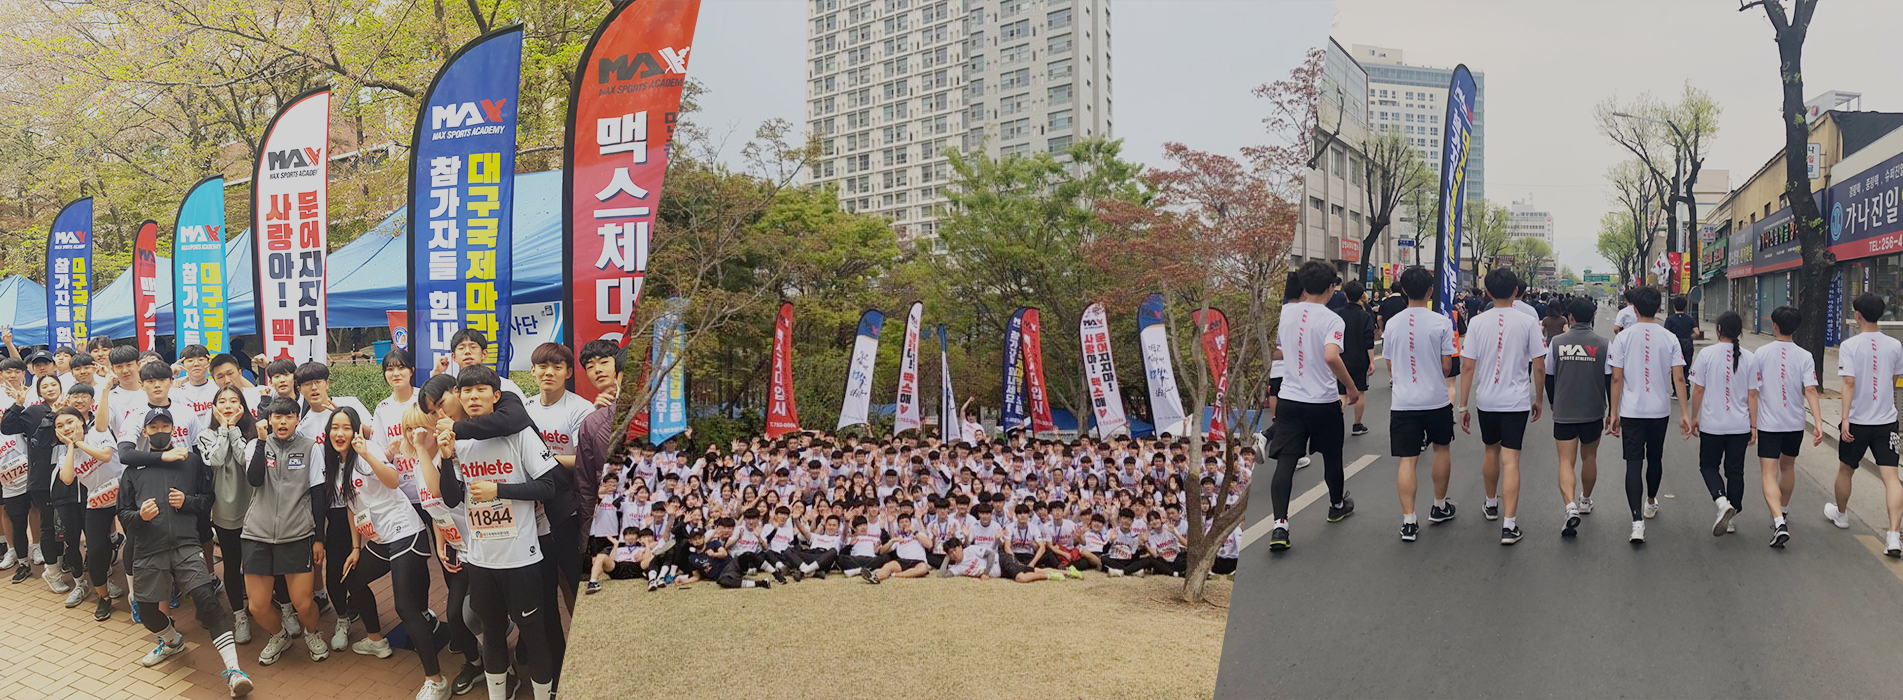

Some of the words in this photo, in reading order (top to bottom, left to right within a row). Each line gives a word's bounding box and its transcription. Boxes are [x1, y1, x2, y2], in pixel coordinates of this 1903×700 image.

[598, 46, 690, 84] MAX
[617, 82, 647, 94] SPORTS
[649, 78, 685, 89] ACADEM
[432, 98, 506, 130] MAX
[432, 131, 447, 141] MAX
[447, 128, 470, 139] SPORTS
[470, 125, 505, 137] ACADEMY
[268, 147, 322, 171] MAX
[428, 156, 461, 281] 참가자들
[594, 111, 650, 344] 맥스체대
[55, 231, 87, 245] MAX
[180, 224, 221, 243] MAX
[54, 257, 70, 322] 참가자들
[201, 262, 224, 353] 대구국제
[1559, 344, 1599, 357] MAX
[1, 462, 28, 481] 11725
[75, 456, 98, 475] Athle
[460, 459, 513, 478] Athlete
[468, 507, 513, 526] 11844
